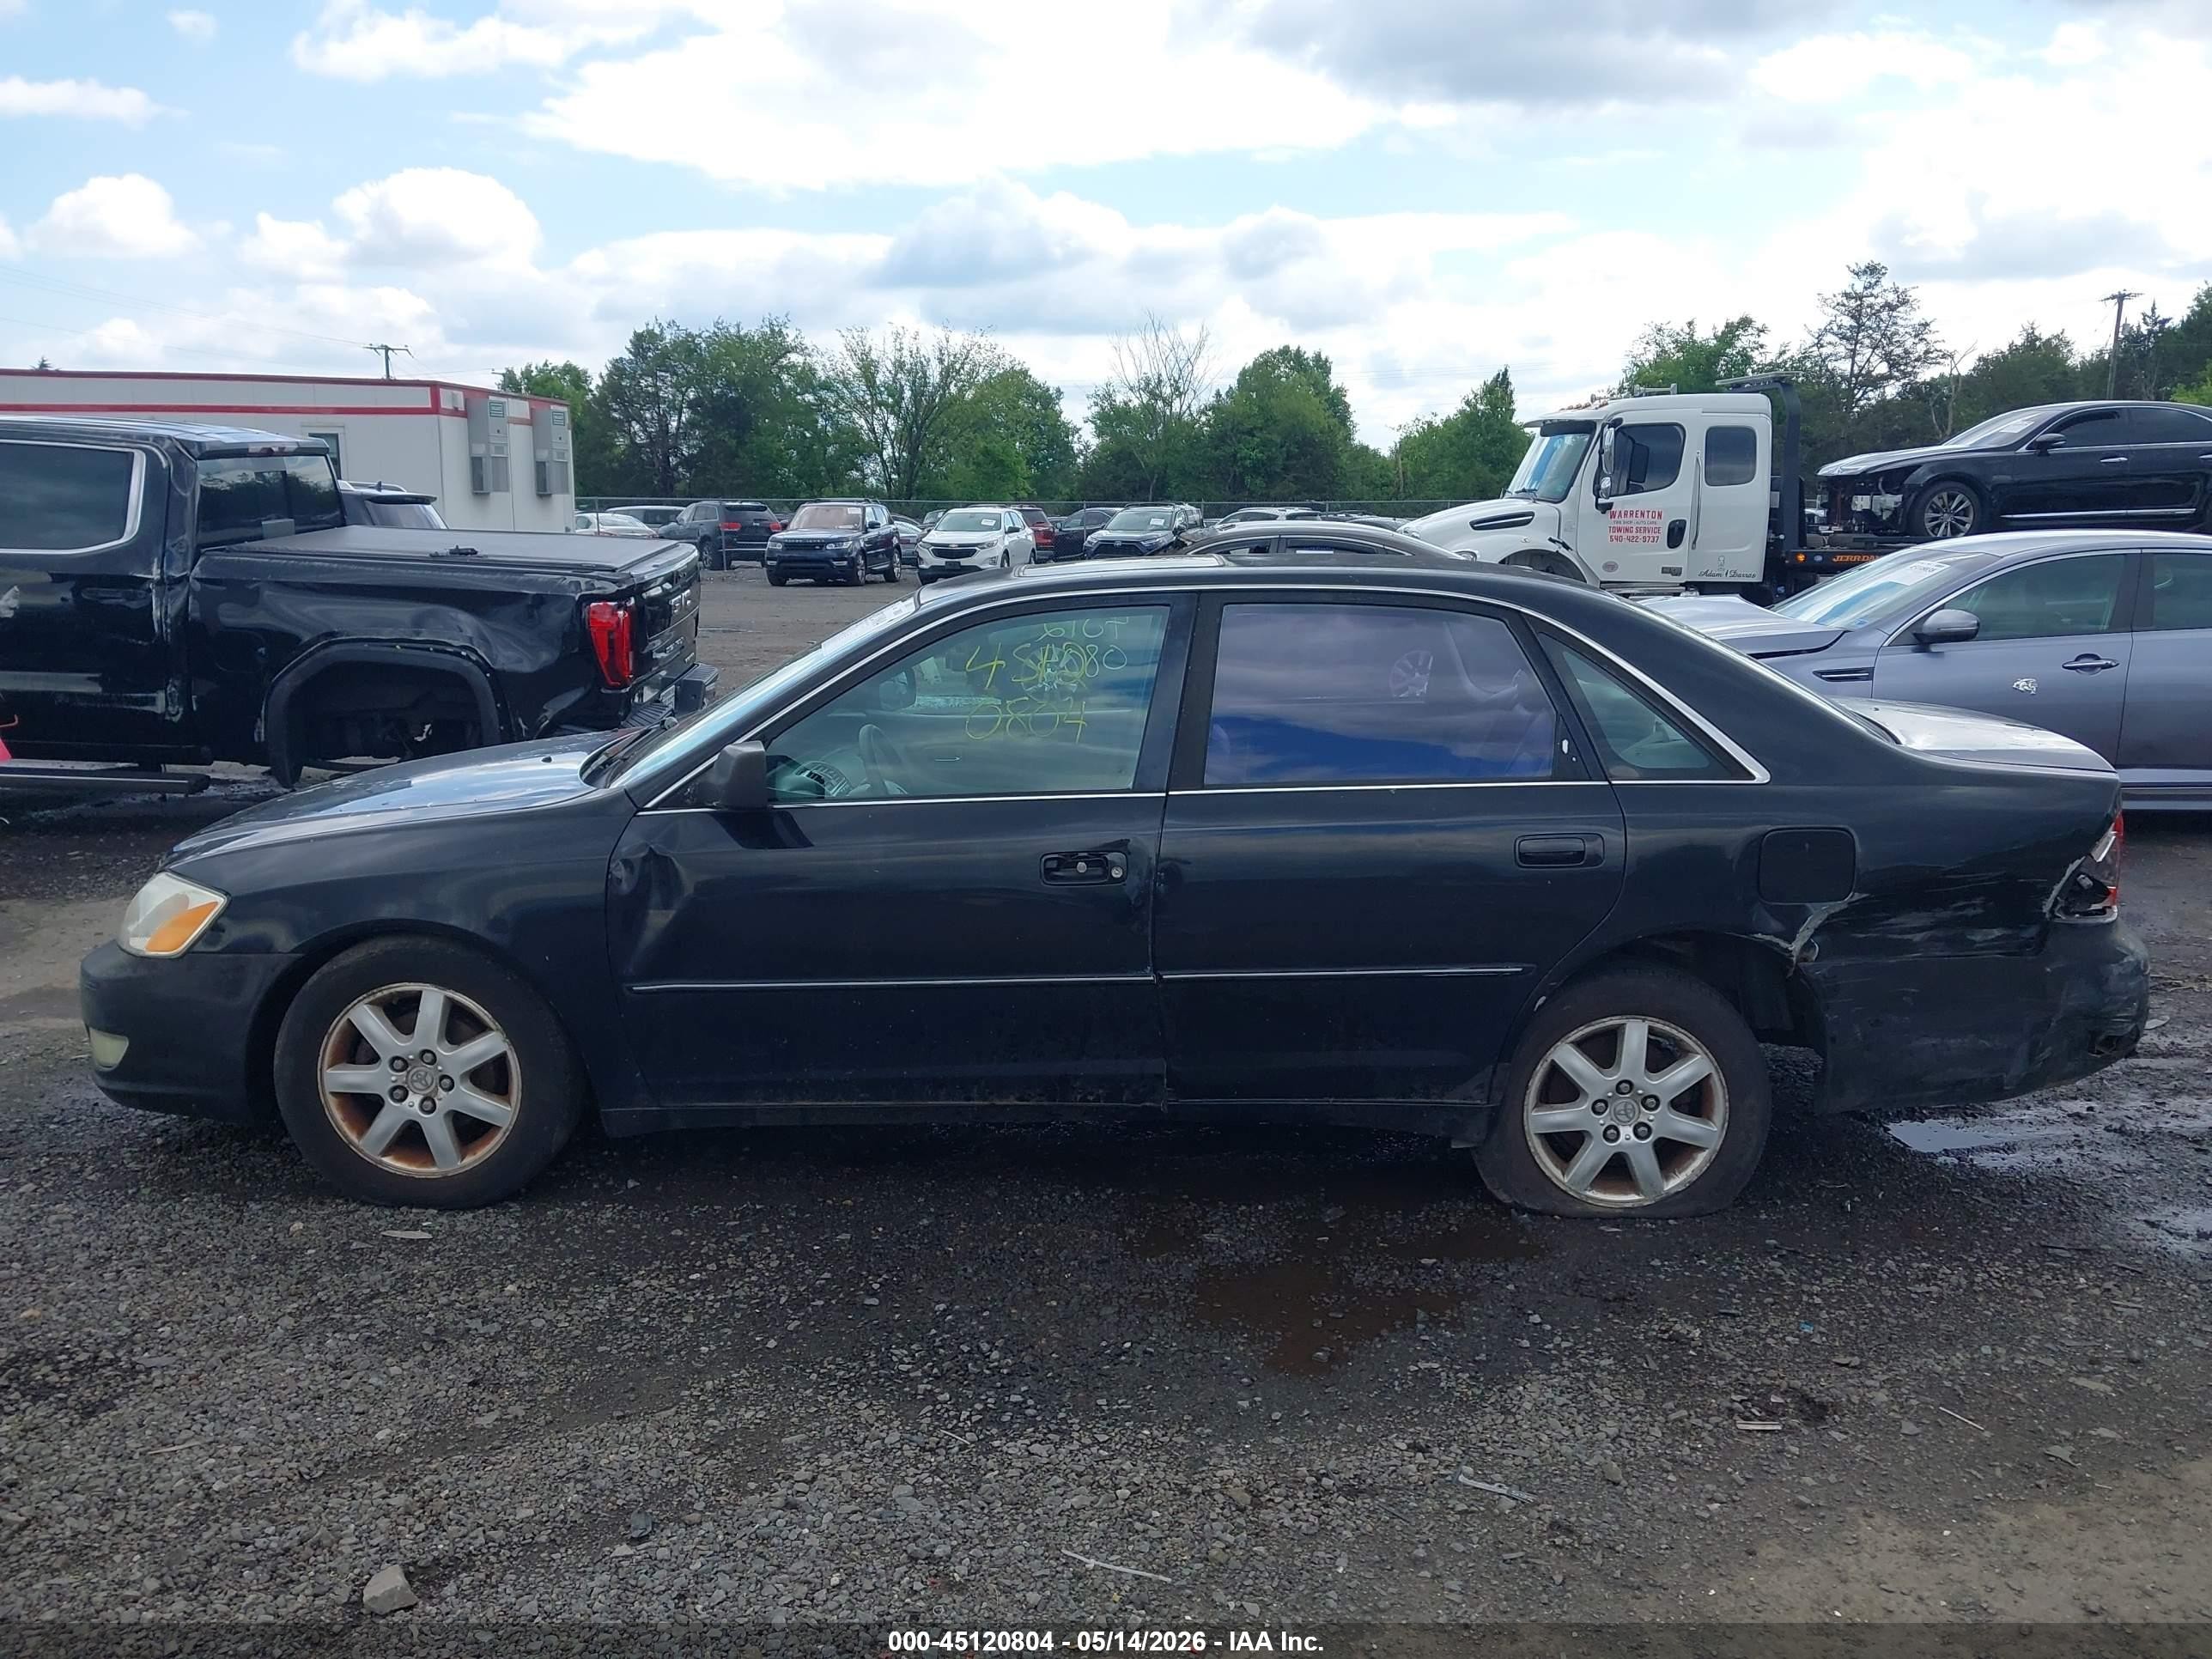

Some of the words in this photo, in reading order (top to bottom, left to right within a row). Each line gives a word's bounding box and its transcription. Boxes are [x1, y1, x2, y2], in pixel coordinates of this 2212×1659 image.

[1609, 510, 1662, 520] WARRENTON
[1608, 526, 1634, 534] TOWING
[1609, 535, 1659, 544] 540-422-9737
